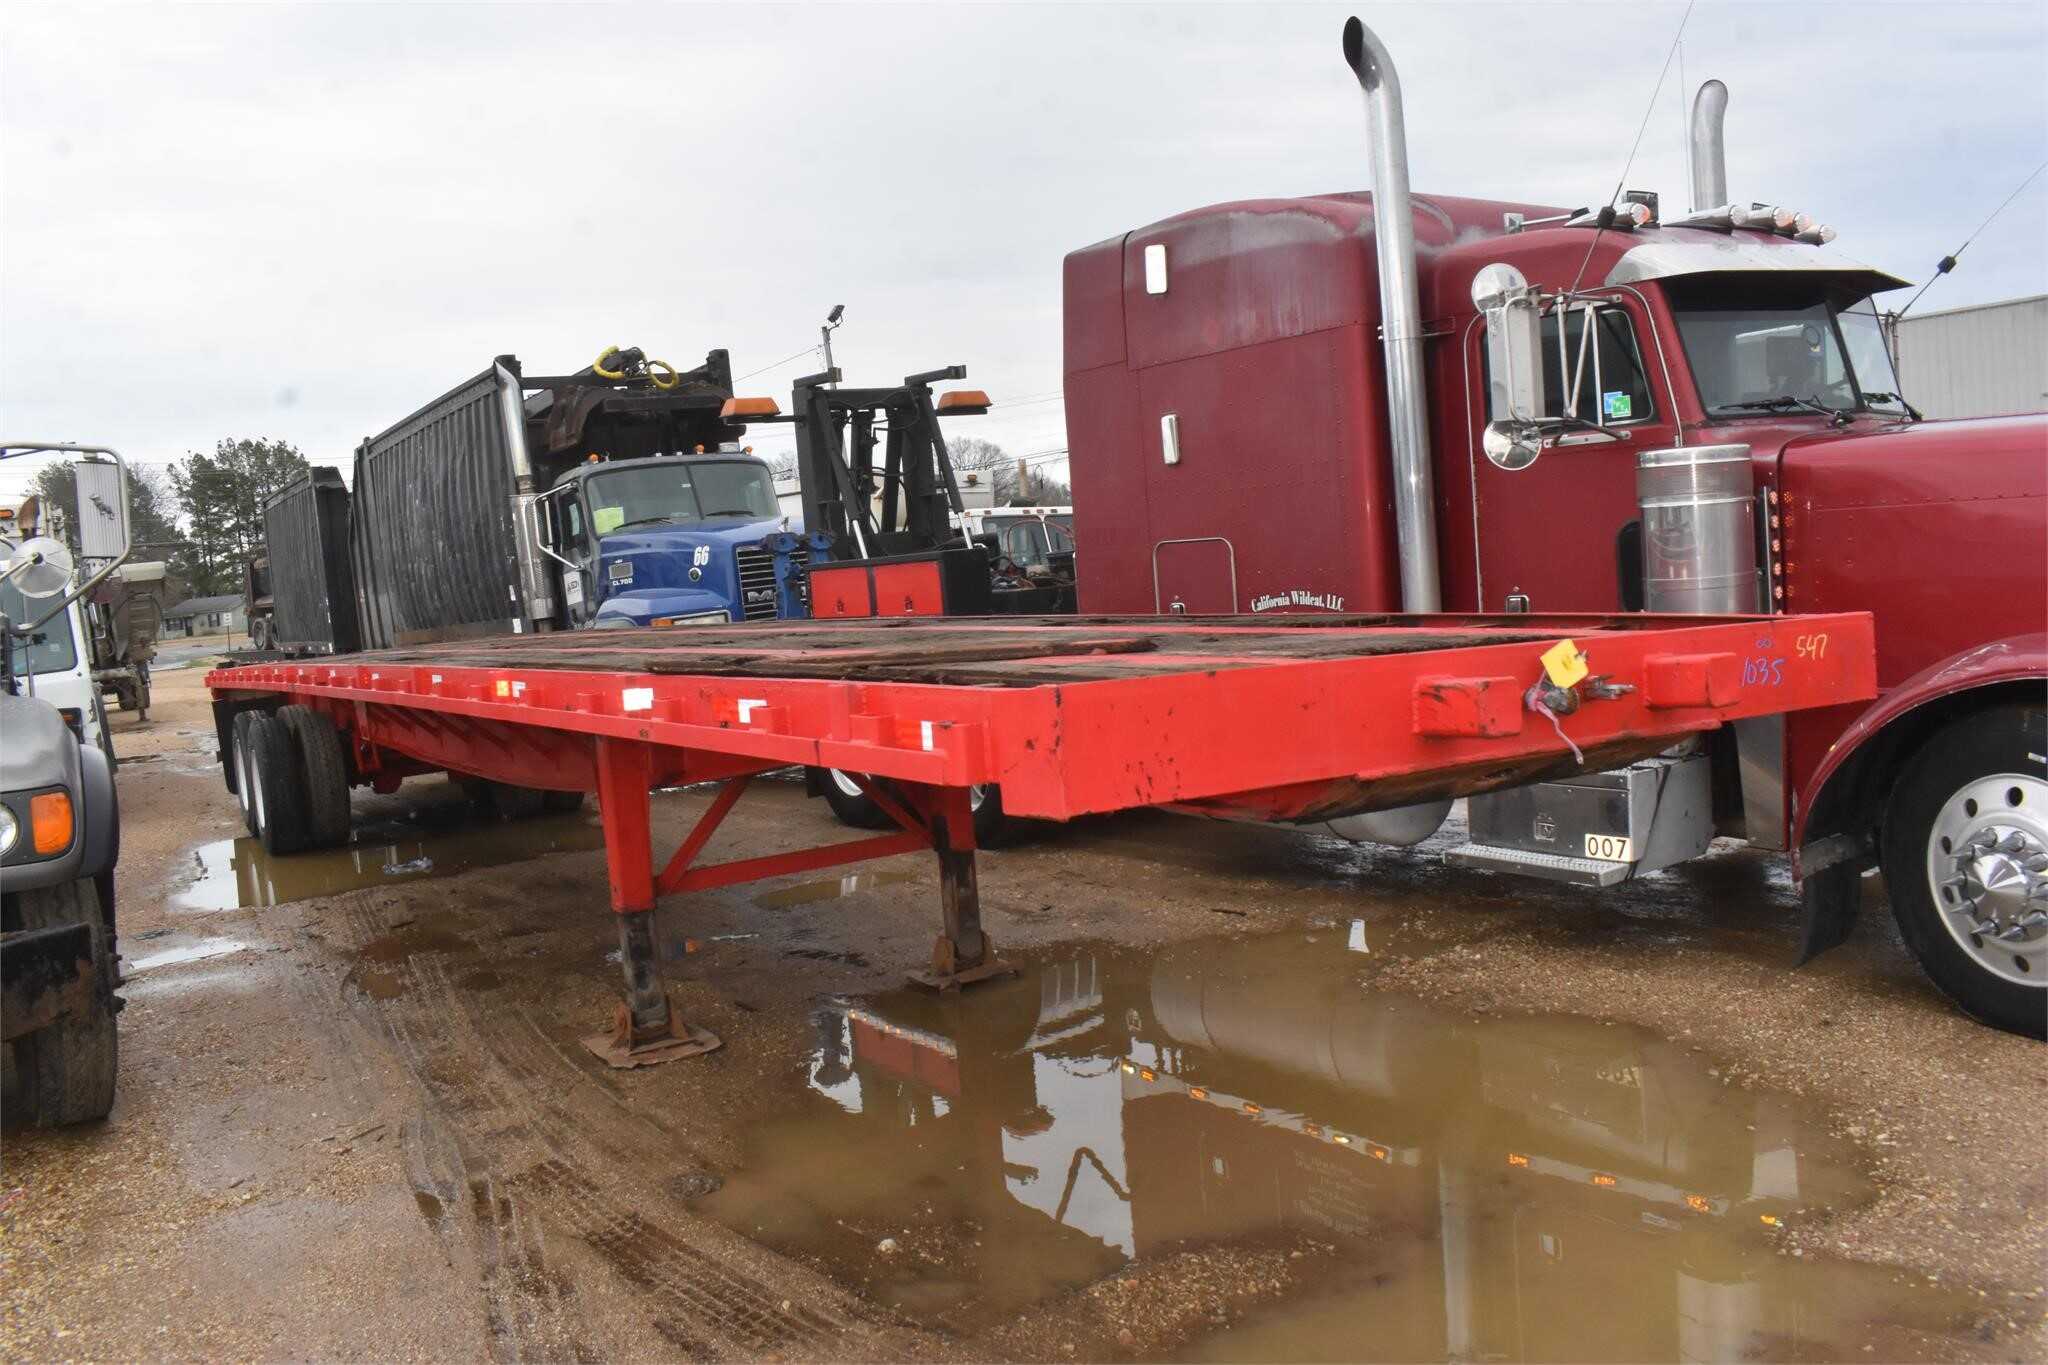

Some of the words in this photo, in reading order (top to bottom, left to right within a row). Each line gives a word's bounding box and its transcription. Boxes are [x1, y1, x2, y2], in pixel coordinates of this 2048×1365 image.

[694, 545, 710, 567] 66
[1251, 592, 1290, 612] California
[1326, 594, 1345, 612] LLC
[1796, 633, 1828, 660] 547
[1742, 656, 1785, 688] 1035
[1588, 836, 1627, 859] 007
